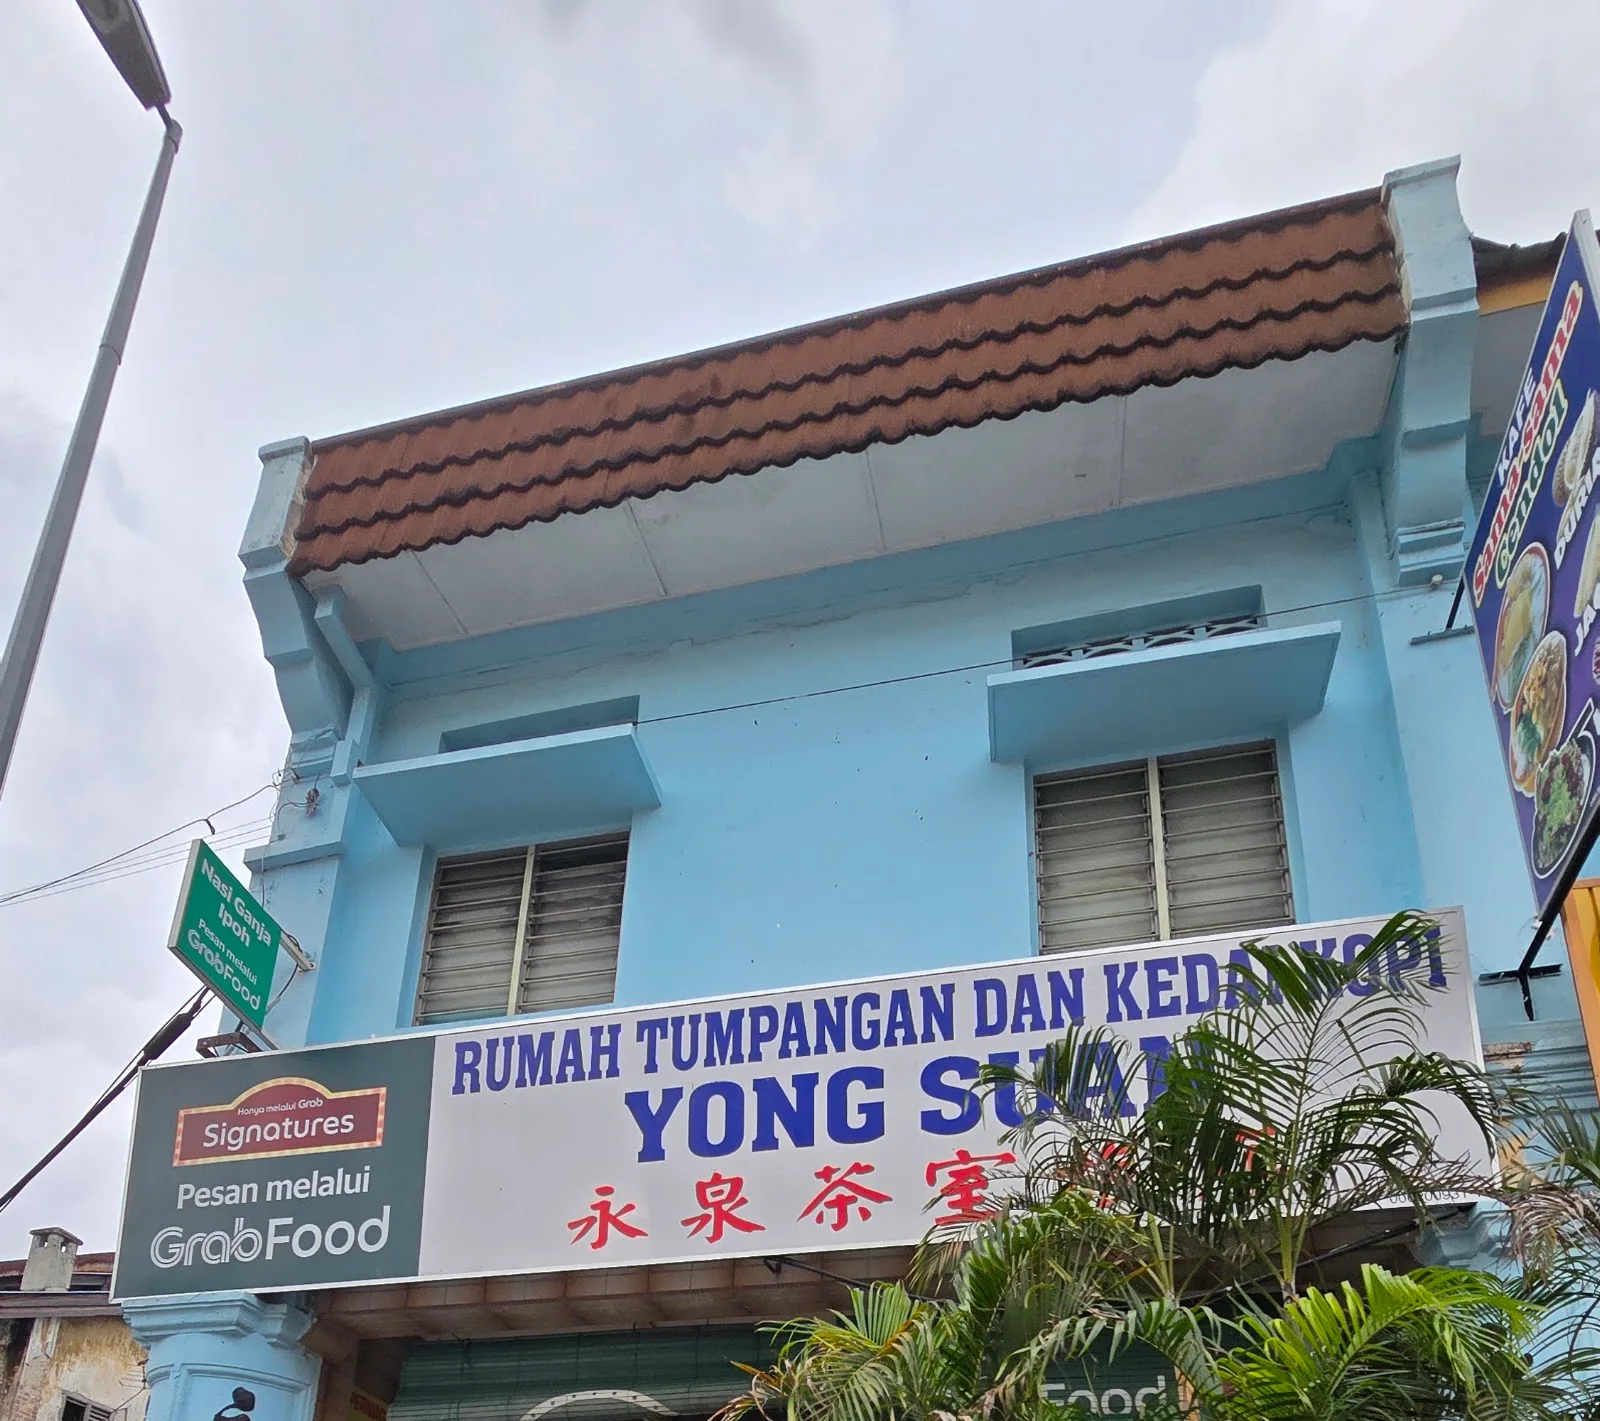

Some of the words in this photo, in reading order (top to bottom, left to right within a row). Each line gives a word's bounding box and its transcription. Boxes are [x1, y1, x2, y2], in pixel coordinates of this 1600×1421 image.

[1499, 368, 1535, 487] KAFE
[201, 858, 233, 903] Nasi
[233, 897, 272, 947] Ganja
[218, 902, 250, 947] Ipoh
[187, 928, 261, 1011] GrabFood
[198, 918, 226, 953] Pesan
[226, 949, 258, 986] melalui
[451, 1023, 623, 1096] RUMAH
[636, 982, 956, 1074] TUMPANGAN
[973, 967, 1086, 1038] DAN
[203, 1113, 355, 1151] Signatures
[237, 1107, 265, 1117] Hanya
[266, 1101, 296, 1113] melalui
[298, 1097, 323, 1109] Grab
[624, 1065, 885, 1163] YONG
[177, 1182, 258, 1210] Pesan
[266, 1165, 371, 1202] melalui
[150, 1205, 391, 1269] GrabFood
